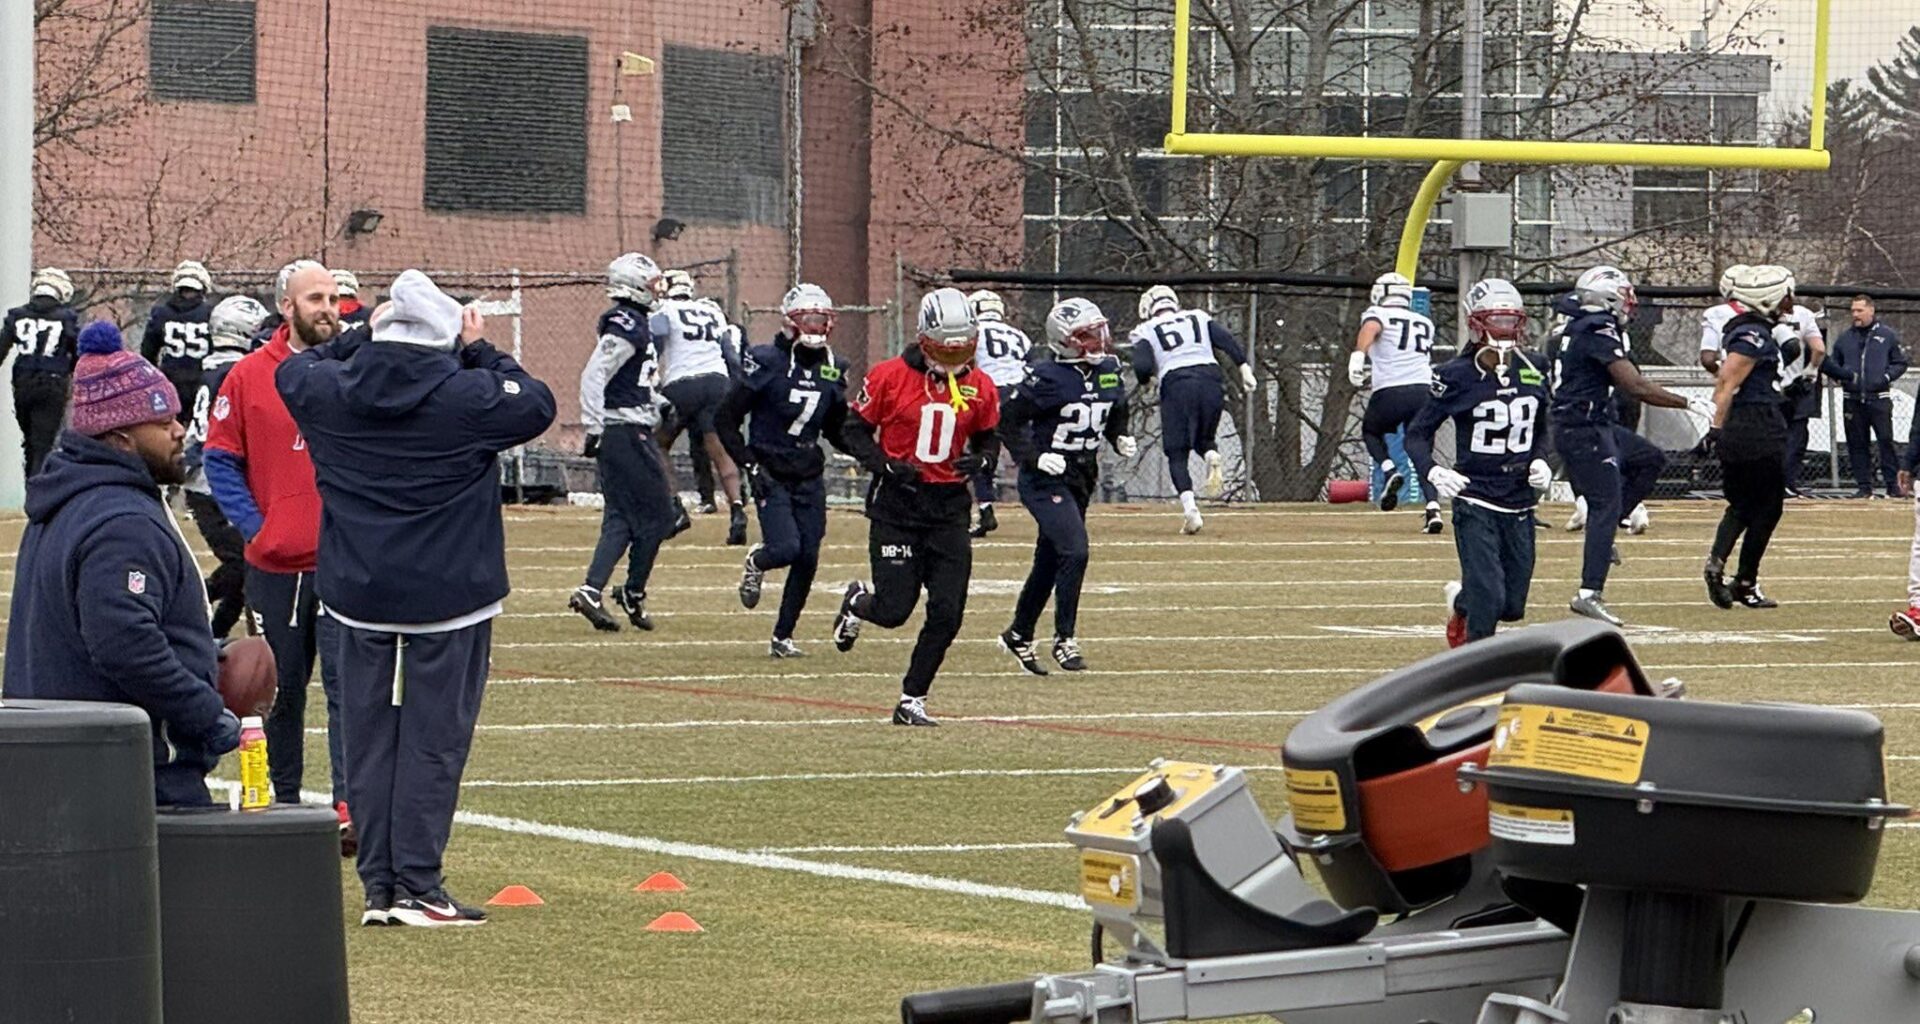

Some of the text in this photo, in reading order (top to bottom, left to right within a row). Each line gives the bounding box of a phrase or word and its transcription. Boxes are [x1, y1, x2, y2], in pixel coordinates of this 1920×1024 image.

[14, 317, 63, 357] 97
[164, 320, 210, 359] 55
[678, 308, 720, 342] 52
[984, 328, 1026, 361] 63
[1153, 314, 1202, 351] 67
[1388, 317, 1430, 356] 72
[787, 387, 822, 437] 7
[1050, 401, 1114, 451] 25
[1469, 394, 1540, 455] 28
[914, 401, 957, 464] 0
